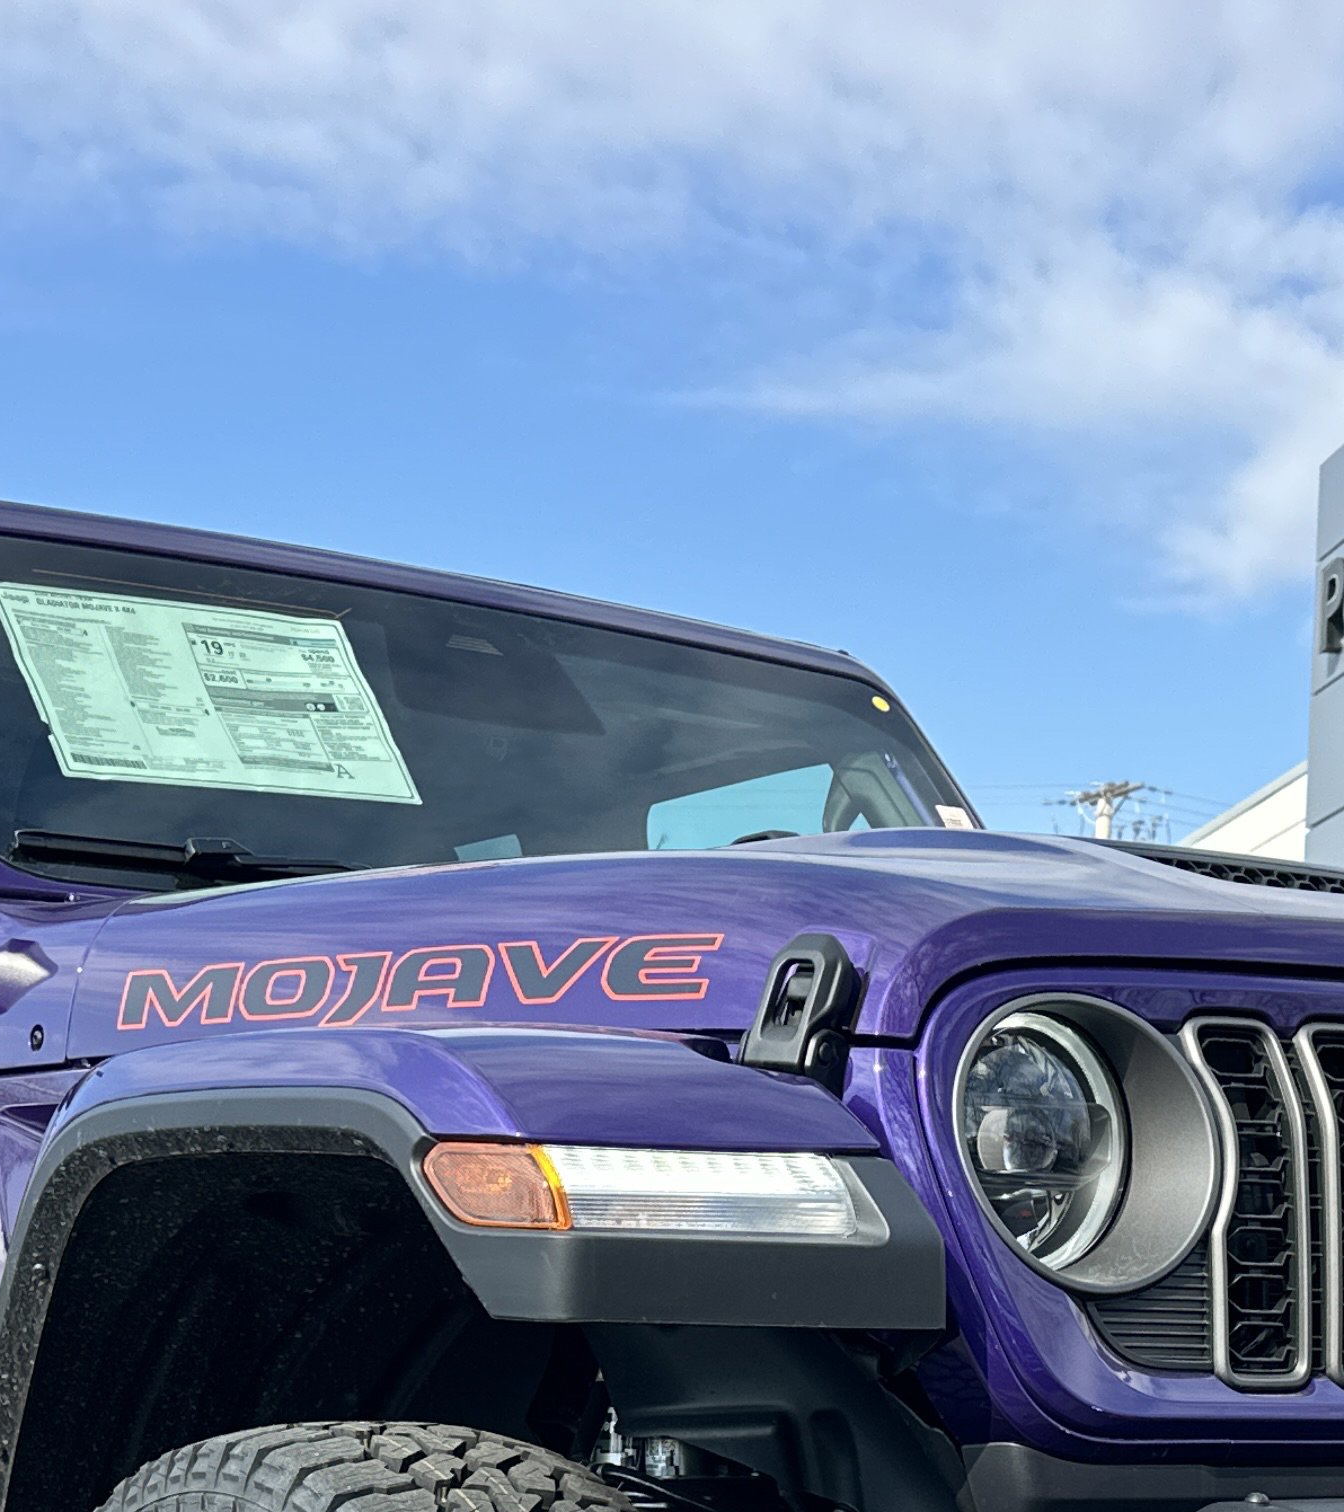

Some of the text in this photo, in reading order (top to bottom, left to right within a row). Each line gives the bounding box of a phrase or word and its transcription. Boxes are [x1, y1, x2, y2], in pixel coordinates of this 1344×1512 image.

[200, 639, 223, 656] 19
[335, 763, 356, 780] A
[117, 934, 725, 1030] MOJAVE
